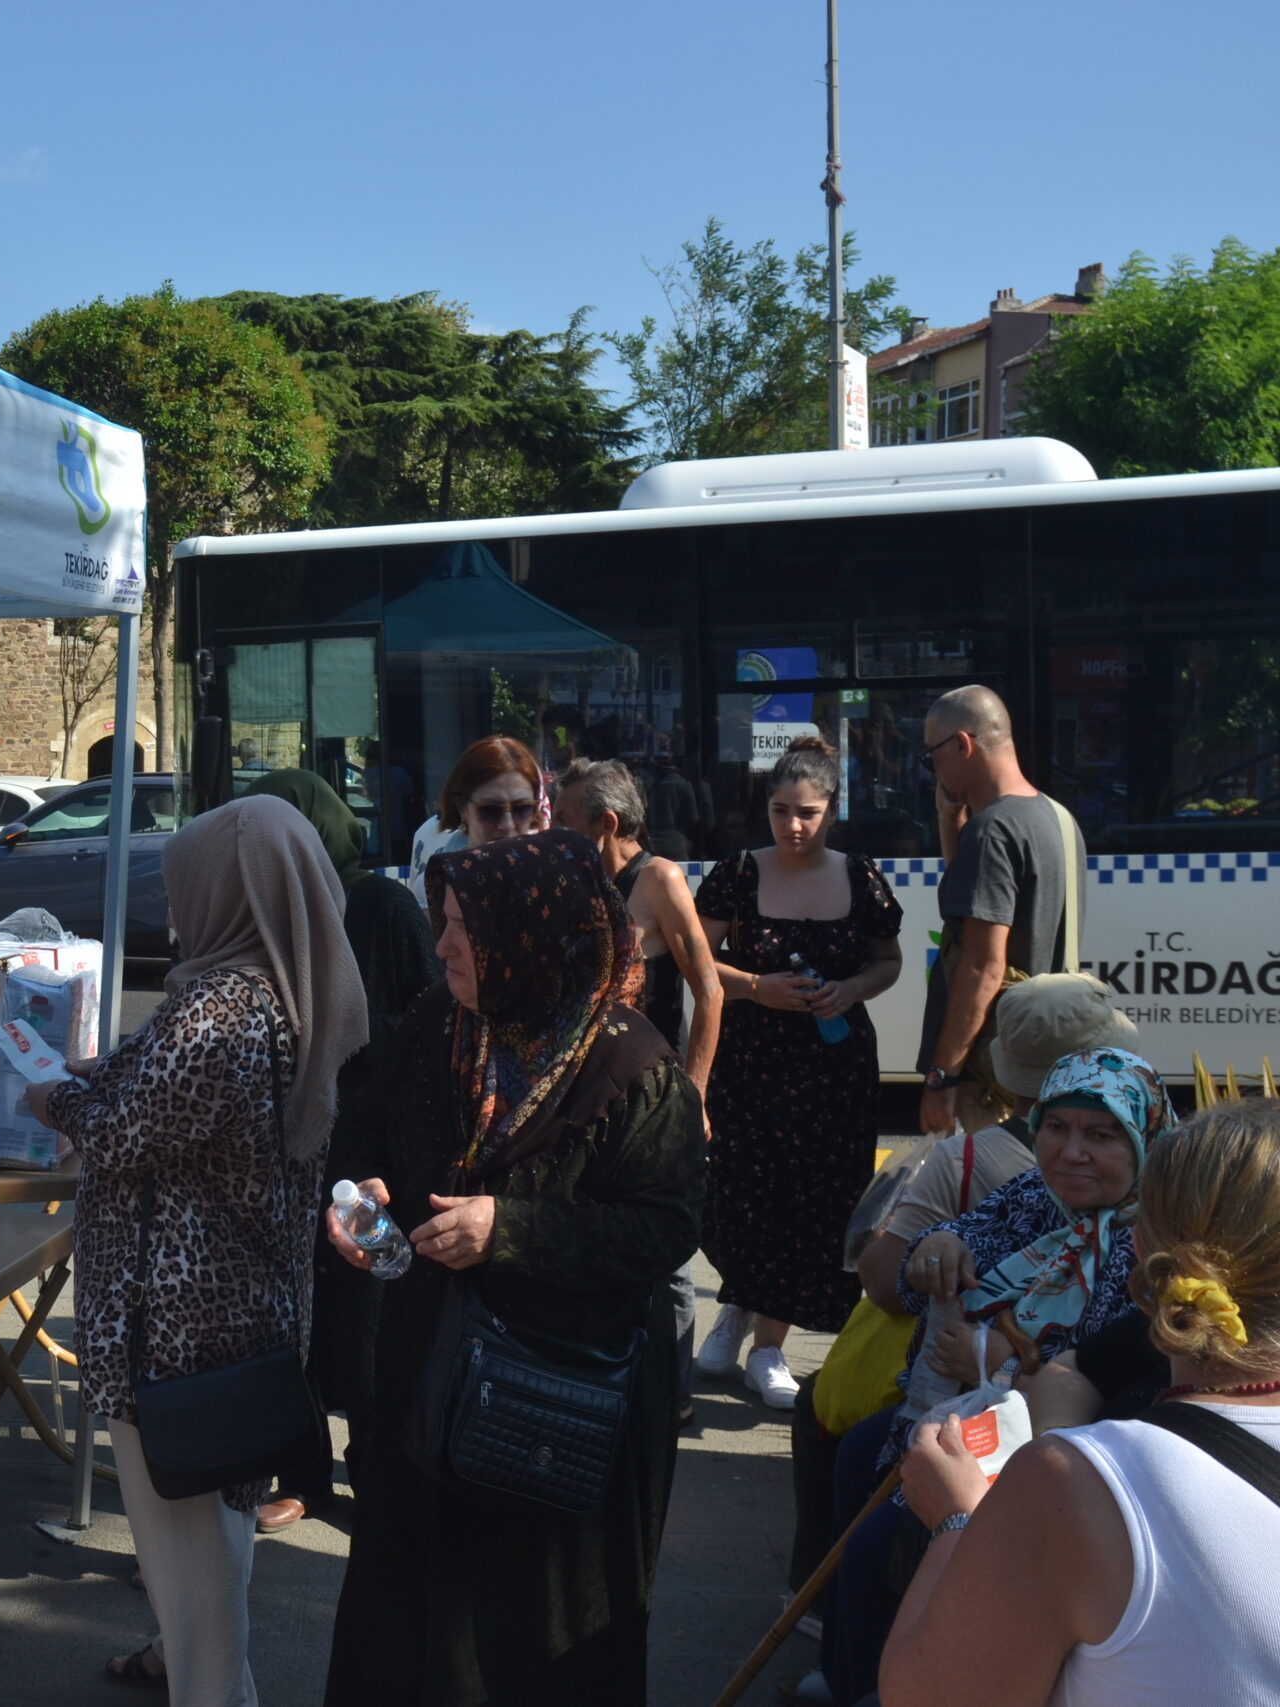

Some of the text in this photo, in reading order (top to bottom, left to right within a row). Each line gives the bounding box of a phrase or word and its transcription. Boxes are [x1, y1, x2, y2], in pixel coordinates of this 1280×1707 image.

[64, 550, 109, 581] TEKİRDAĞ
[752, 731, 792, 750] TEKİRD
[1145, 931, 1193, 952] T.C.
[1079, 948, 1280, 997] KİRDAĞ
